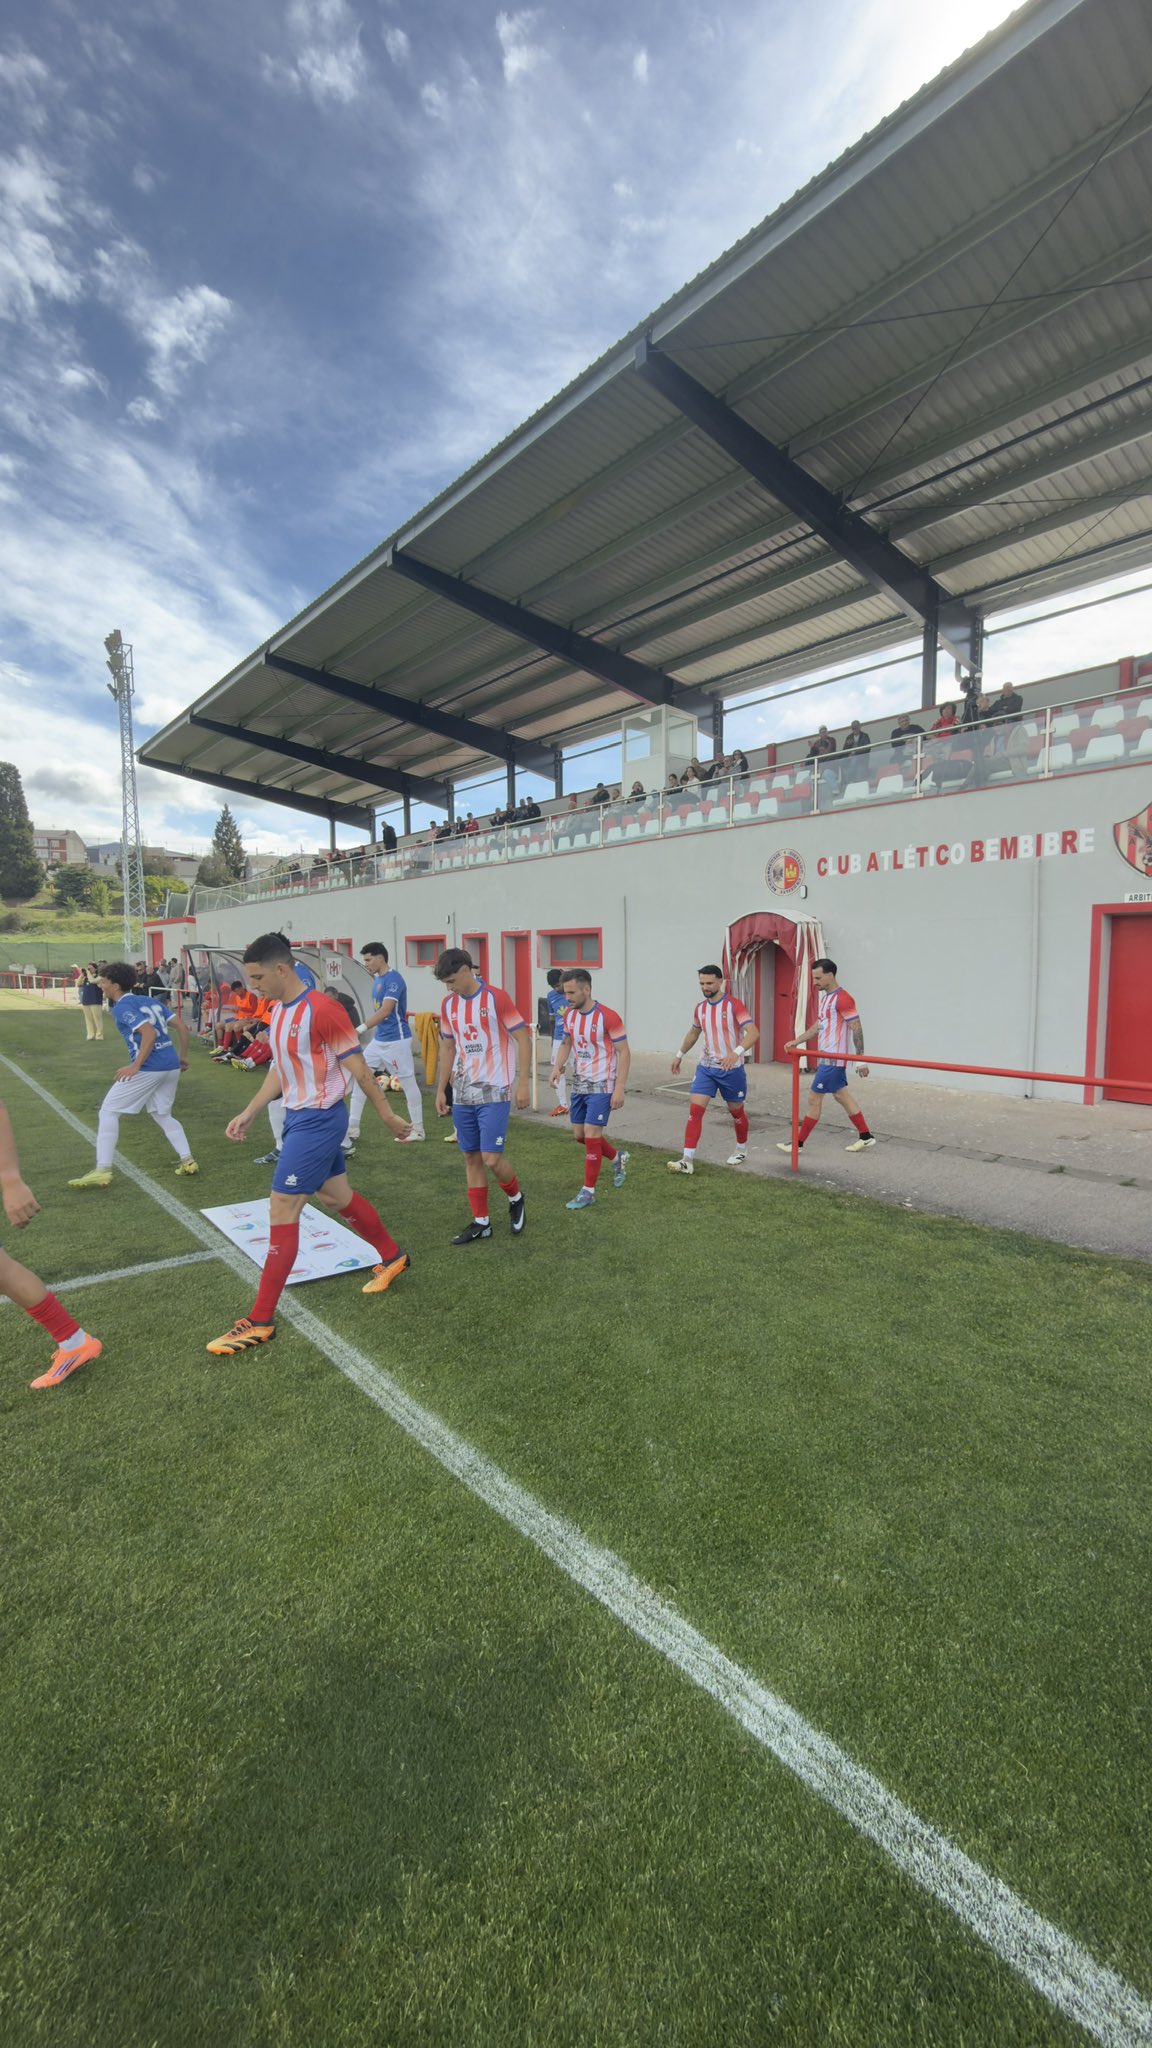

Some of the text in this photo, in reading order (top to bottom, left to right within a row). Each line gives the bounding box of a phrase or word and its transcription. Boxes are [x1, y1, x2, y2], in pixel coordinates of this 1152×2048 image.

[817, 853, 861, 877] CLUB
[866, 842, 966, 872] ATLÉTICO
[970, 828, 1095, 863] BEMBIBRE
[1129, 893, 1152, 902] ARBIT
